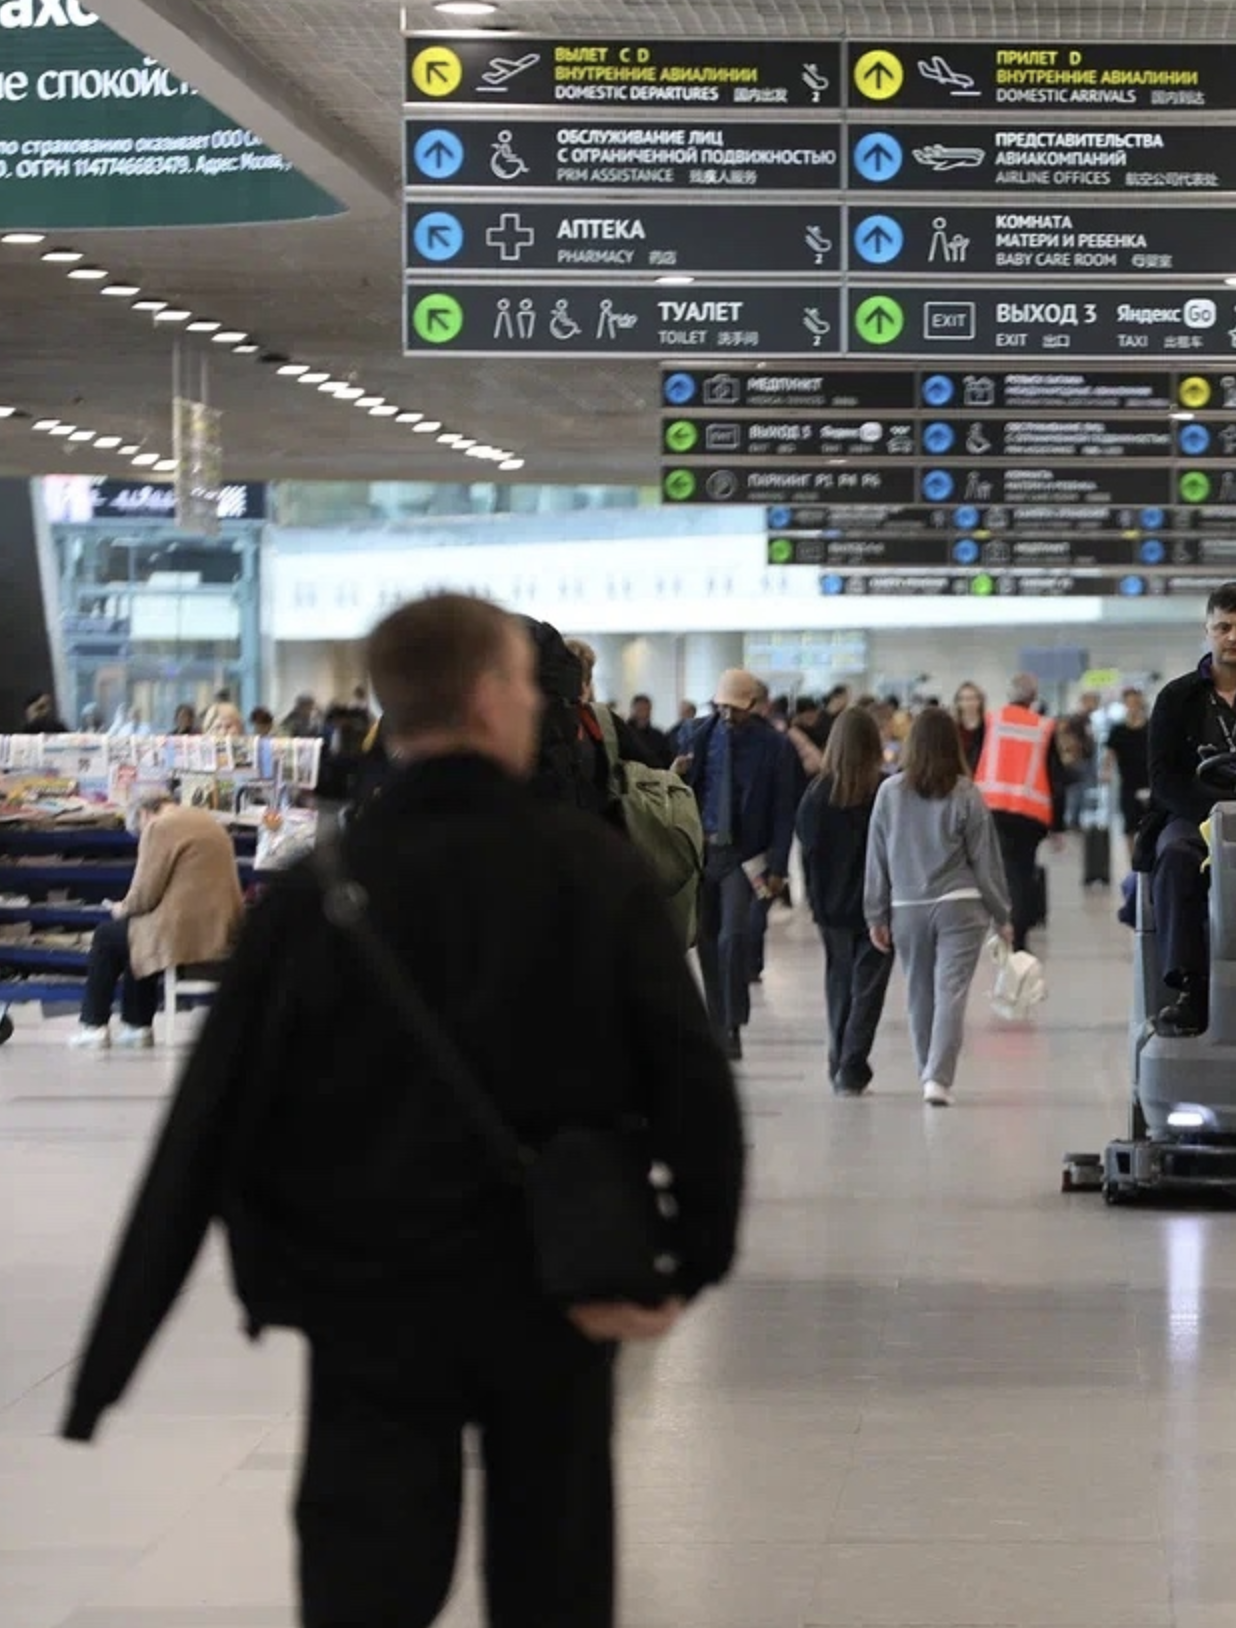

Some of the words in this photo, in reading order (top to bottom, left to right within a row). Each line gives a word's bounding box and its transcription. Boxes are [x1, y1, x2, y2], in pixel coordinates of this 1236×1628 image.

[554, 47, 608, 62] ВЫЛЕТ
[638, 47, 650, 61] D
[996, 51, 1058, 66] ПРИЛЕТ
[1069, 51, 1081, 65] D
[0, 71, 28, 101] е
[37, 56, 199, 101] спокойс
[554, 67, 656, 81] ВНУТРЕННИЕ
[660, 67, 758, 82] АВИАЛИНИИ
[996, 70, 1097, 85] ВНУТРЕННИЕ
[1100, 70, 1198, 85] АВИАЛИНИИ
[554, 86, 628, 100] DOMESTIC
[630, 86, 719, 100] DEPARTURES
[996, 88, 1069, 103] DOMESTIC
[1070, 88, 1137, 103] ARRIVALS
[557, 130, 685, 145] ОБСЛУЖИВАНИЕ
[687, 130, 724, 148] ЛИЦ
[996, 133, 1164, 150] ПРЕДСТАВИТЕЛЬСТВА
[573, 147, 698, 164] ОГРАНИЧЕННОЙ
[700, 149, 837, 167] ПОДВИЖНОСТЬЮ
[996, 148, 1126, 166] АВИАКОМПАНИЙ
[15, 159, 71, 179] ОГРН
[557, 168, 586, 183] PRM
[588, 168, 675, 183] ASSISTANCE
[996, 171, 1051, 185] AIRLINE
[1053, 171, 1111, 185] OFFICES
[557, 219, 646, 239] АПТЕКА
[995, 215, 1073, 230] КОМНАТА
[995, 234, 1060, 248] МАТЕРИ
[1063, 234, 1074, 248] И
[1078, 234, 1147, 248] РЕБЕНКА
[557, 250, 635, 265] PHARMACY
[995, 254, 1033, 267] BABY
[1035, 254, 1071, 267] CARE
[1074, 254, 1117, 267] ROOM
[658, 302, 744, 322] ТУАЛЕТ
[996, 304, 1078, 325] ВЫХОД
[1084, 304, 1097, 323] 3
[1117, 304, 1182, 325] Яндекс
[1187, 305, 1213, 322] Go
[931, 314, 966, 328] EXIT
[658, 331, 707, 345] TOILET
[996, 334, 1028, 347] EXIT
[1117, 335, 1149, 348] TAXI
